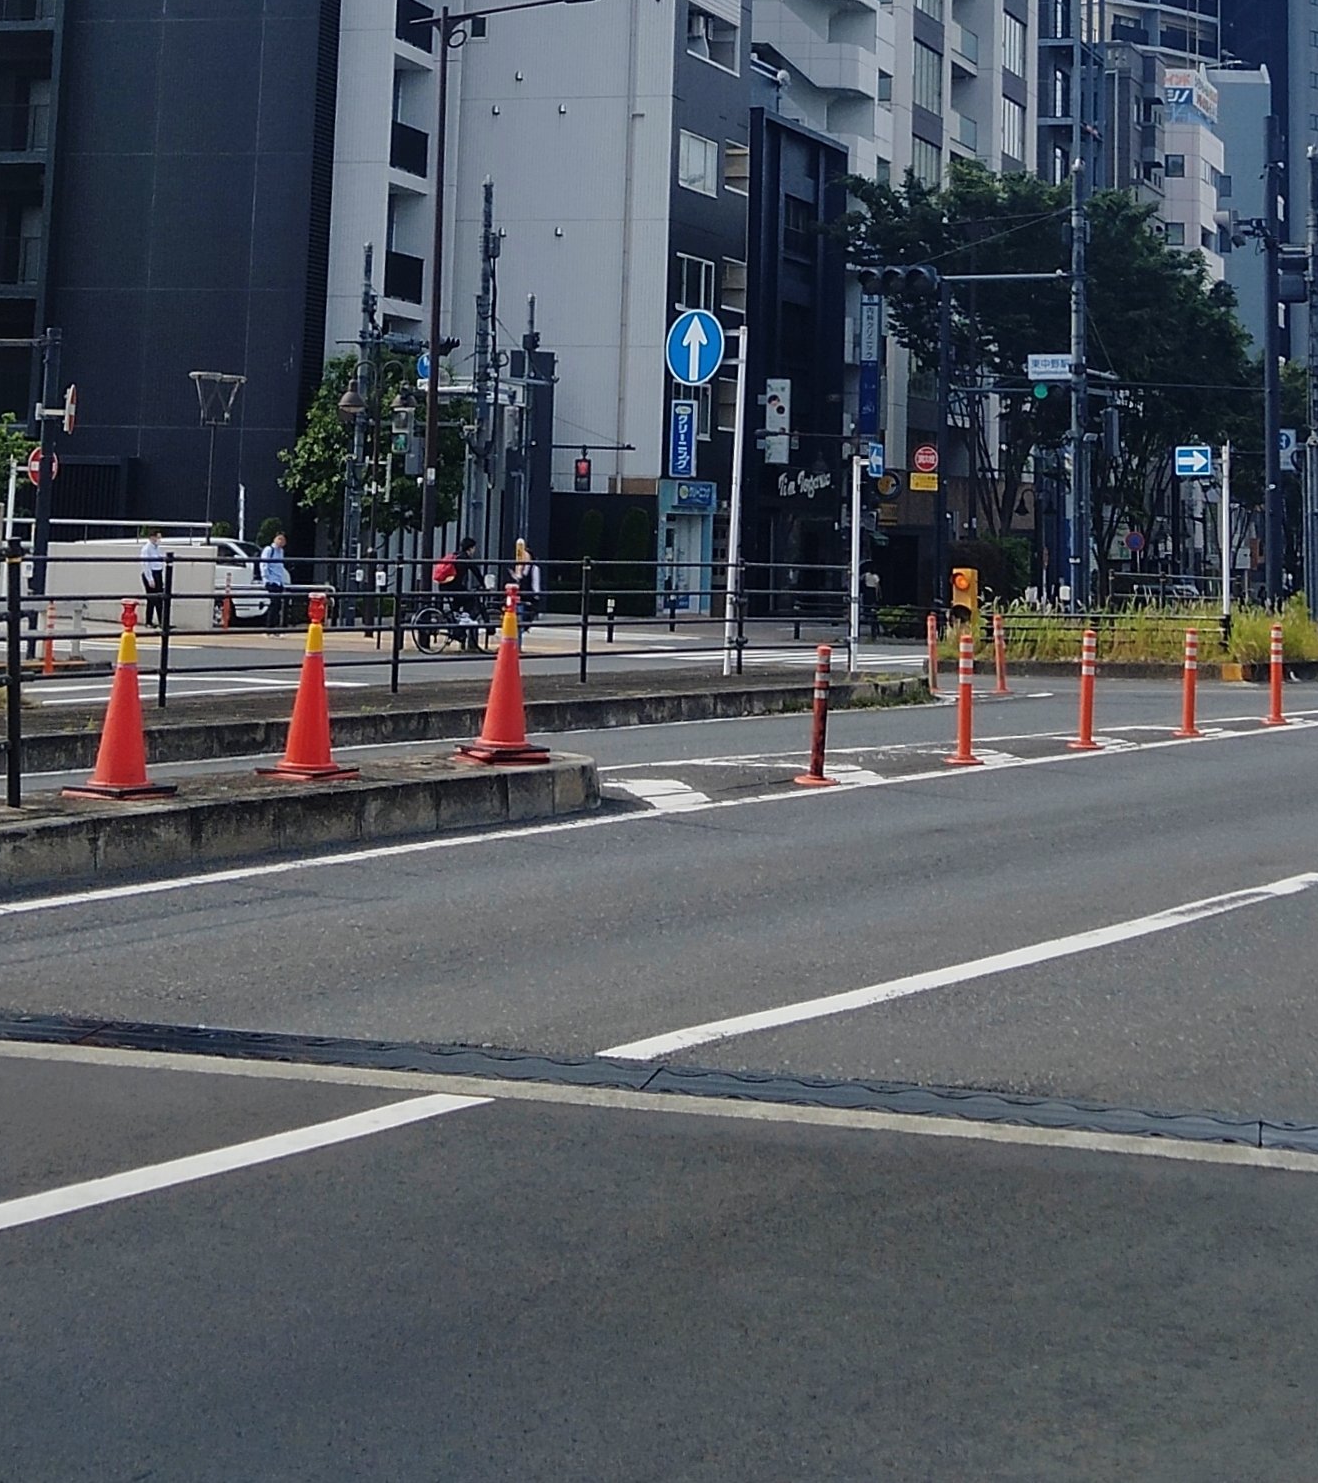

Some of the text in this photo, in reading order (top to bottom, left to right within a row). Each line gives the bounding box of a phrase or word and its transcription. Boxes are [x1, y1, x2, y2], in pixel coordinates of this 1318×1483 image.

[676, 415, 690, 469] クリーニング
